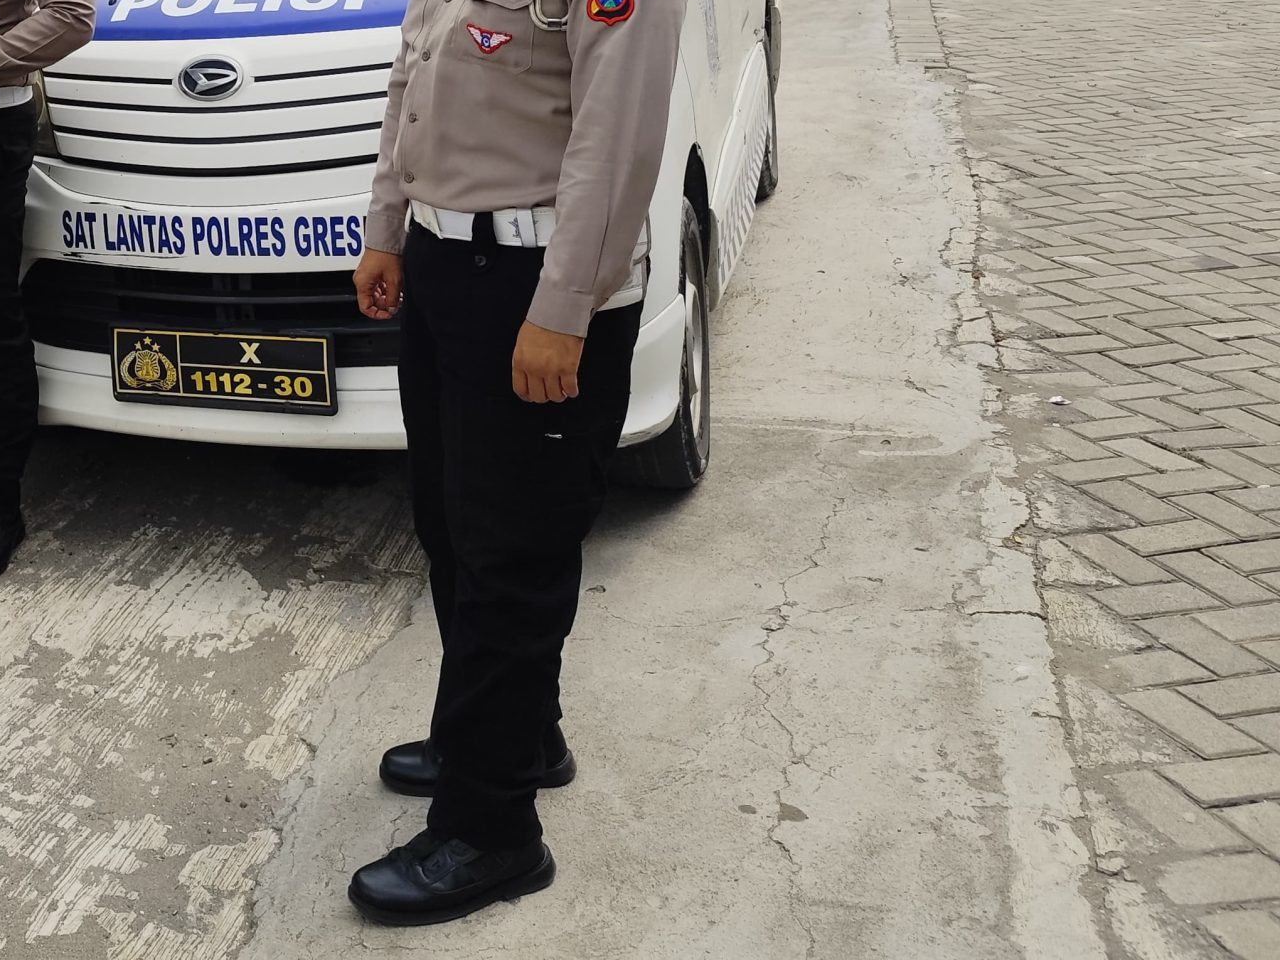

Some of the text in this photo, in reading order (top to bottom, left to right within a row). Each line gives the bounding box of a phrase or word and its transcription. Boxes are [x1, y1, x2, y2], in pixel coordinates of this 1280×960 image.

[62, 210, 367, 258] SAT LANTAS POLRES GRES
[239, 342, 262, 364] X
[191, 371, 253, 395] 1112
[273, 375, 314, 398] 30
